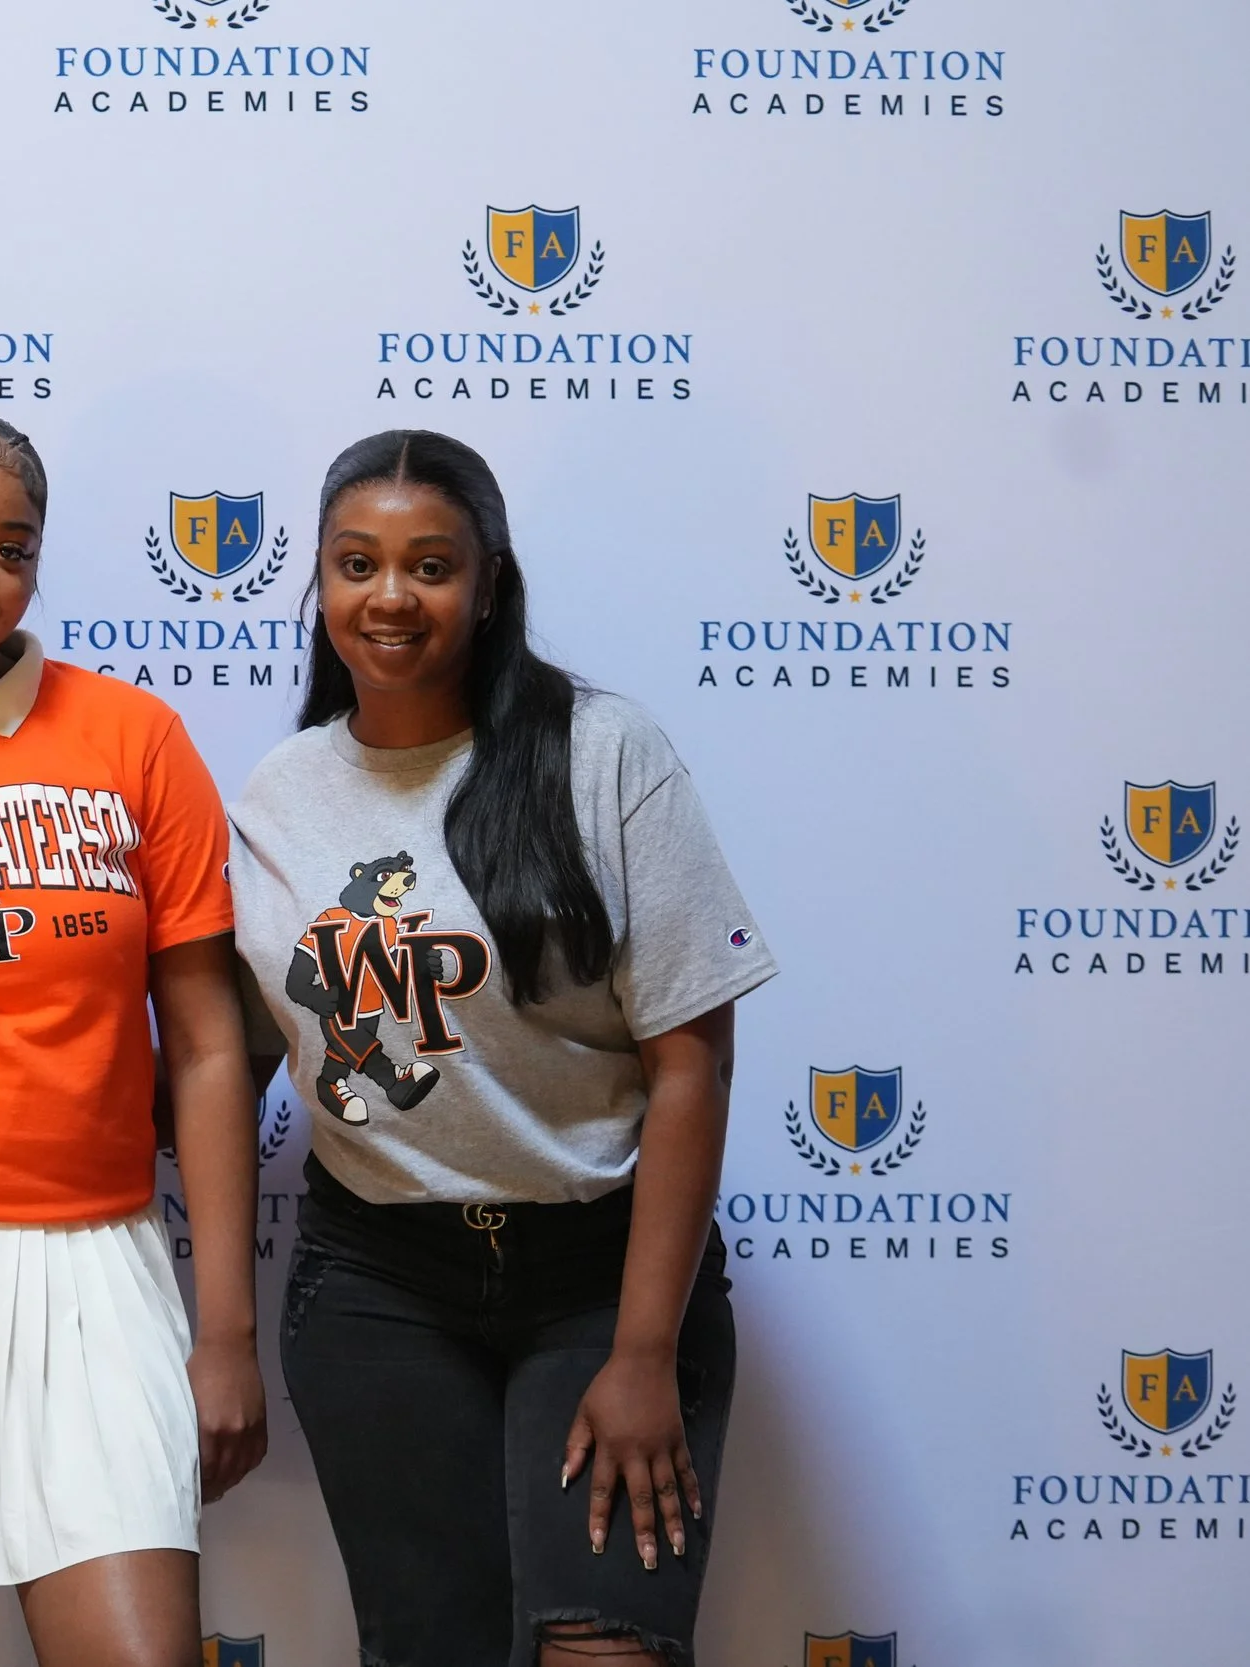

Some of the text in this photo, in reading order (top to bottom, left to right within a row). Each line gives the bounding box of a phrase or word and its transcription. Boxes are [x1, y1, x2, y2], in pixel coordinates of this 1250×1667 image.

[57, 47, 370, 76] FOUNDATION
[694, 49, 1004, 80] FOUNDATION
[54, 91, 368, 112] ACADEMIES
[693, 93, 1003, 116] ACADEMIES
[379, 334, 691, 363] FOUNDATION
[1014, 337, 1250, 367] FOUNDATI
[377, 378, 690, 400] ACADEMIES
[1013, 381, 1246, 403] ACADEMI
[61, 620, 305, 650] FOUNDATI
[700, 622, 1011, 652] FOUNDATION
[699, 666, 1009, 688] ACADEMIES
[52, 909, 110, 940] 1855
[1017, 909, 1250, 938] FOUNDATI
[1015, 953, 1249, 974] ACADEMI
[714, 1193, 1011, 1223] OUNDATION
[734, 1237, 1008, 1259] CADEMIES
[1014, 1475, 1250, 1504] FOUNDATI
[1010, 1518, 1243, 1540] ACADEMI
